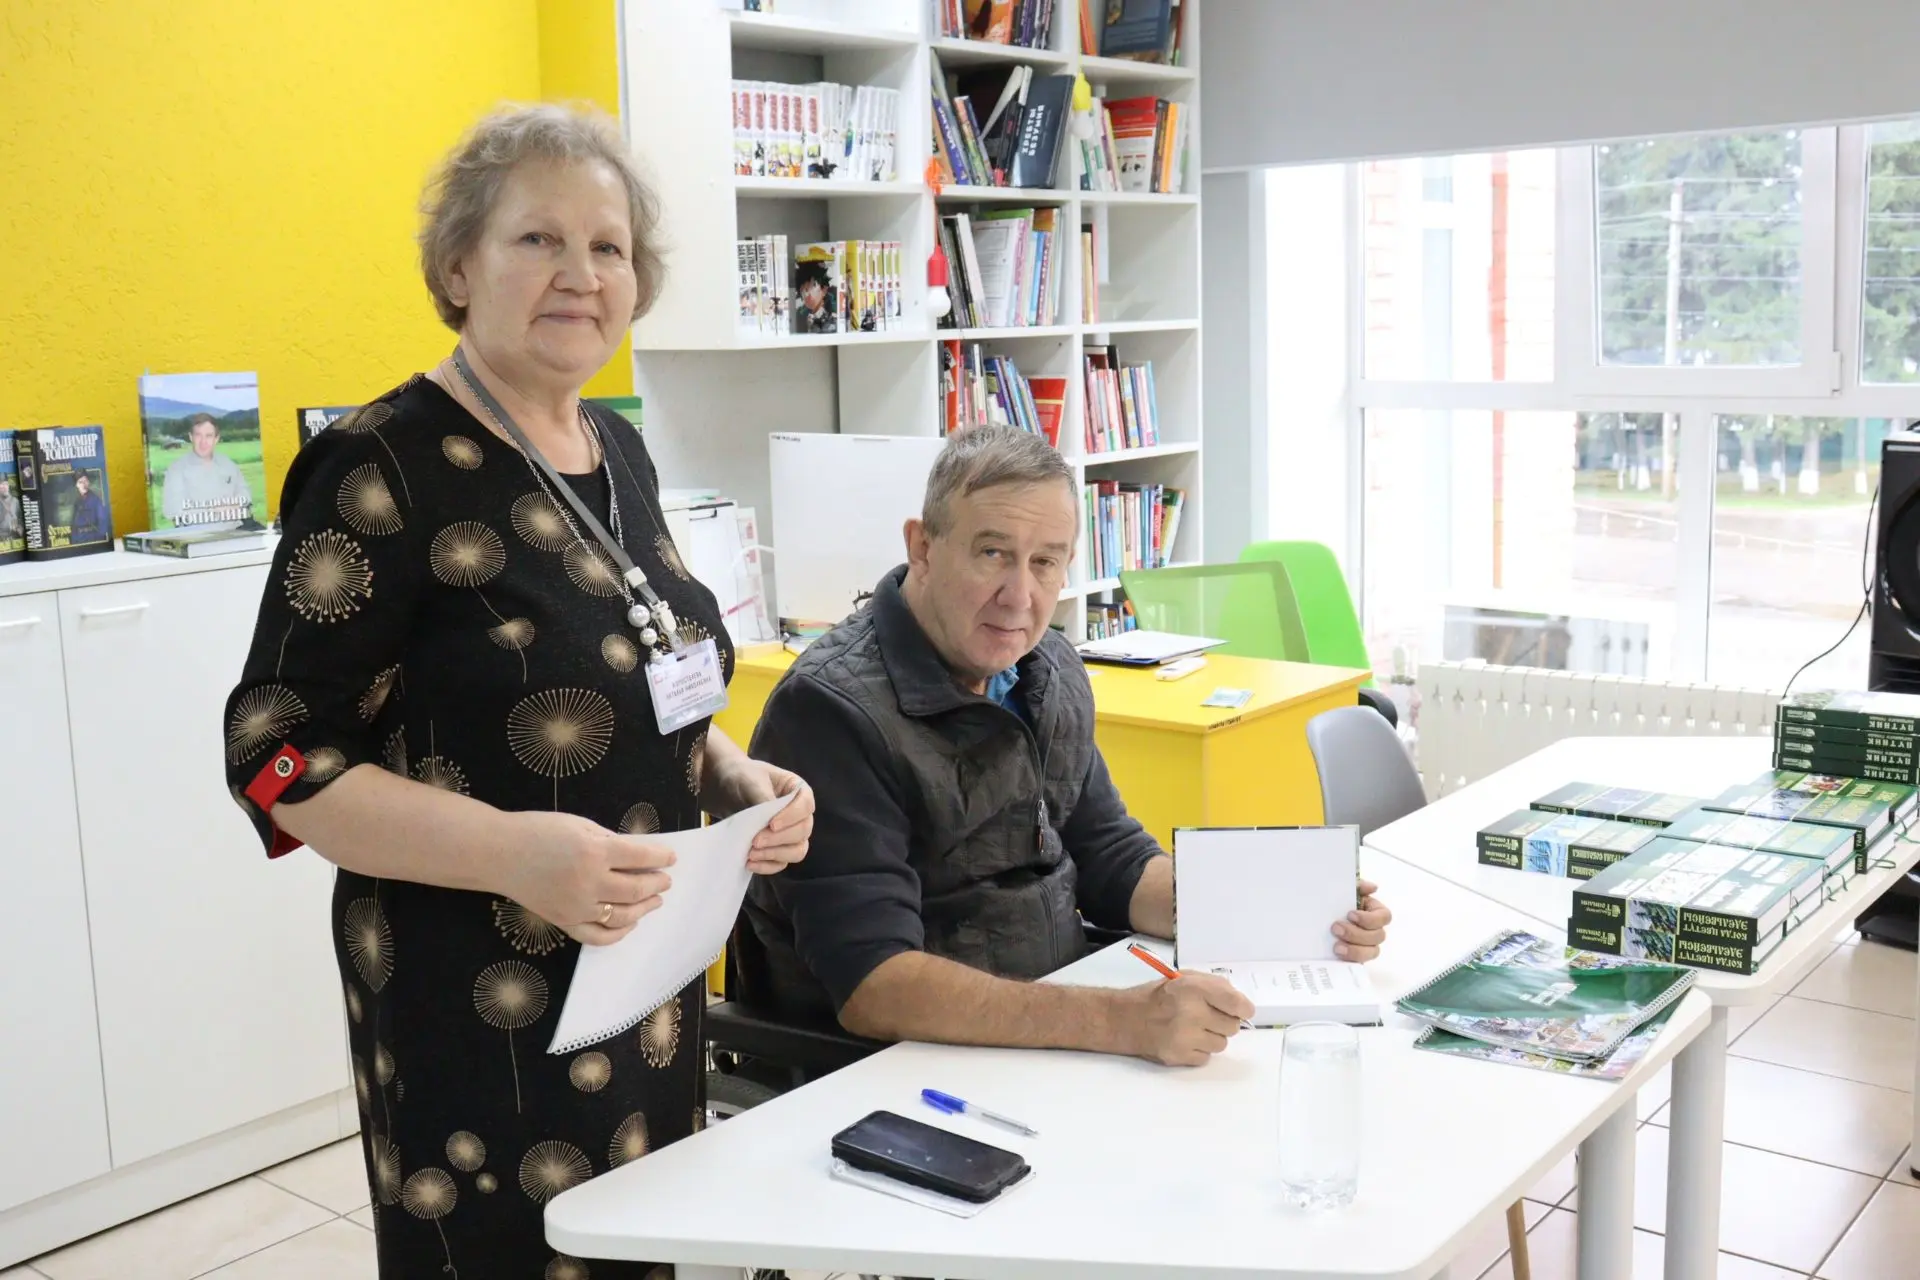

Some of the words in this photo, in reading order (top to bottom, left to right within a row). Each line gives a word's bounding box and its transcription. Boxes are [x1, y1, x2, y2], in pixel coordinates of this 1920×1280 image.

[1021, 108, 1036, 154] ХРЕБТЫ
[1028, 105, 1045, 156] БЕЗУМИЯ
[1869, 721, 1914, 731] ПУТНИК
[1867, 738, 1912, 749] ПУТНИК
[1866, 754, 1911, 765] ПУТНИК
[1864, 770, 1908, 780] ПУТНИК
[1683, 912, 1748, 931] ЭДЕЛЬВЕЙСЫ
[1682, 924, 1718, 937] ЦВЕТУТ
[1719, 929, 1747, 941] КОГДА
[1678, 940, 1743, 958] ЭДЕЛЬВЕЙСЫ
[1677, 952, 1714, 965] ЦВЕТУТ
[1714, 957, 1743, 969] КОГДА
